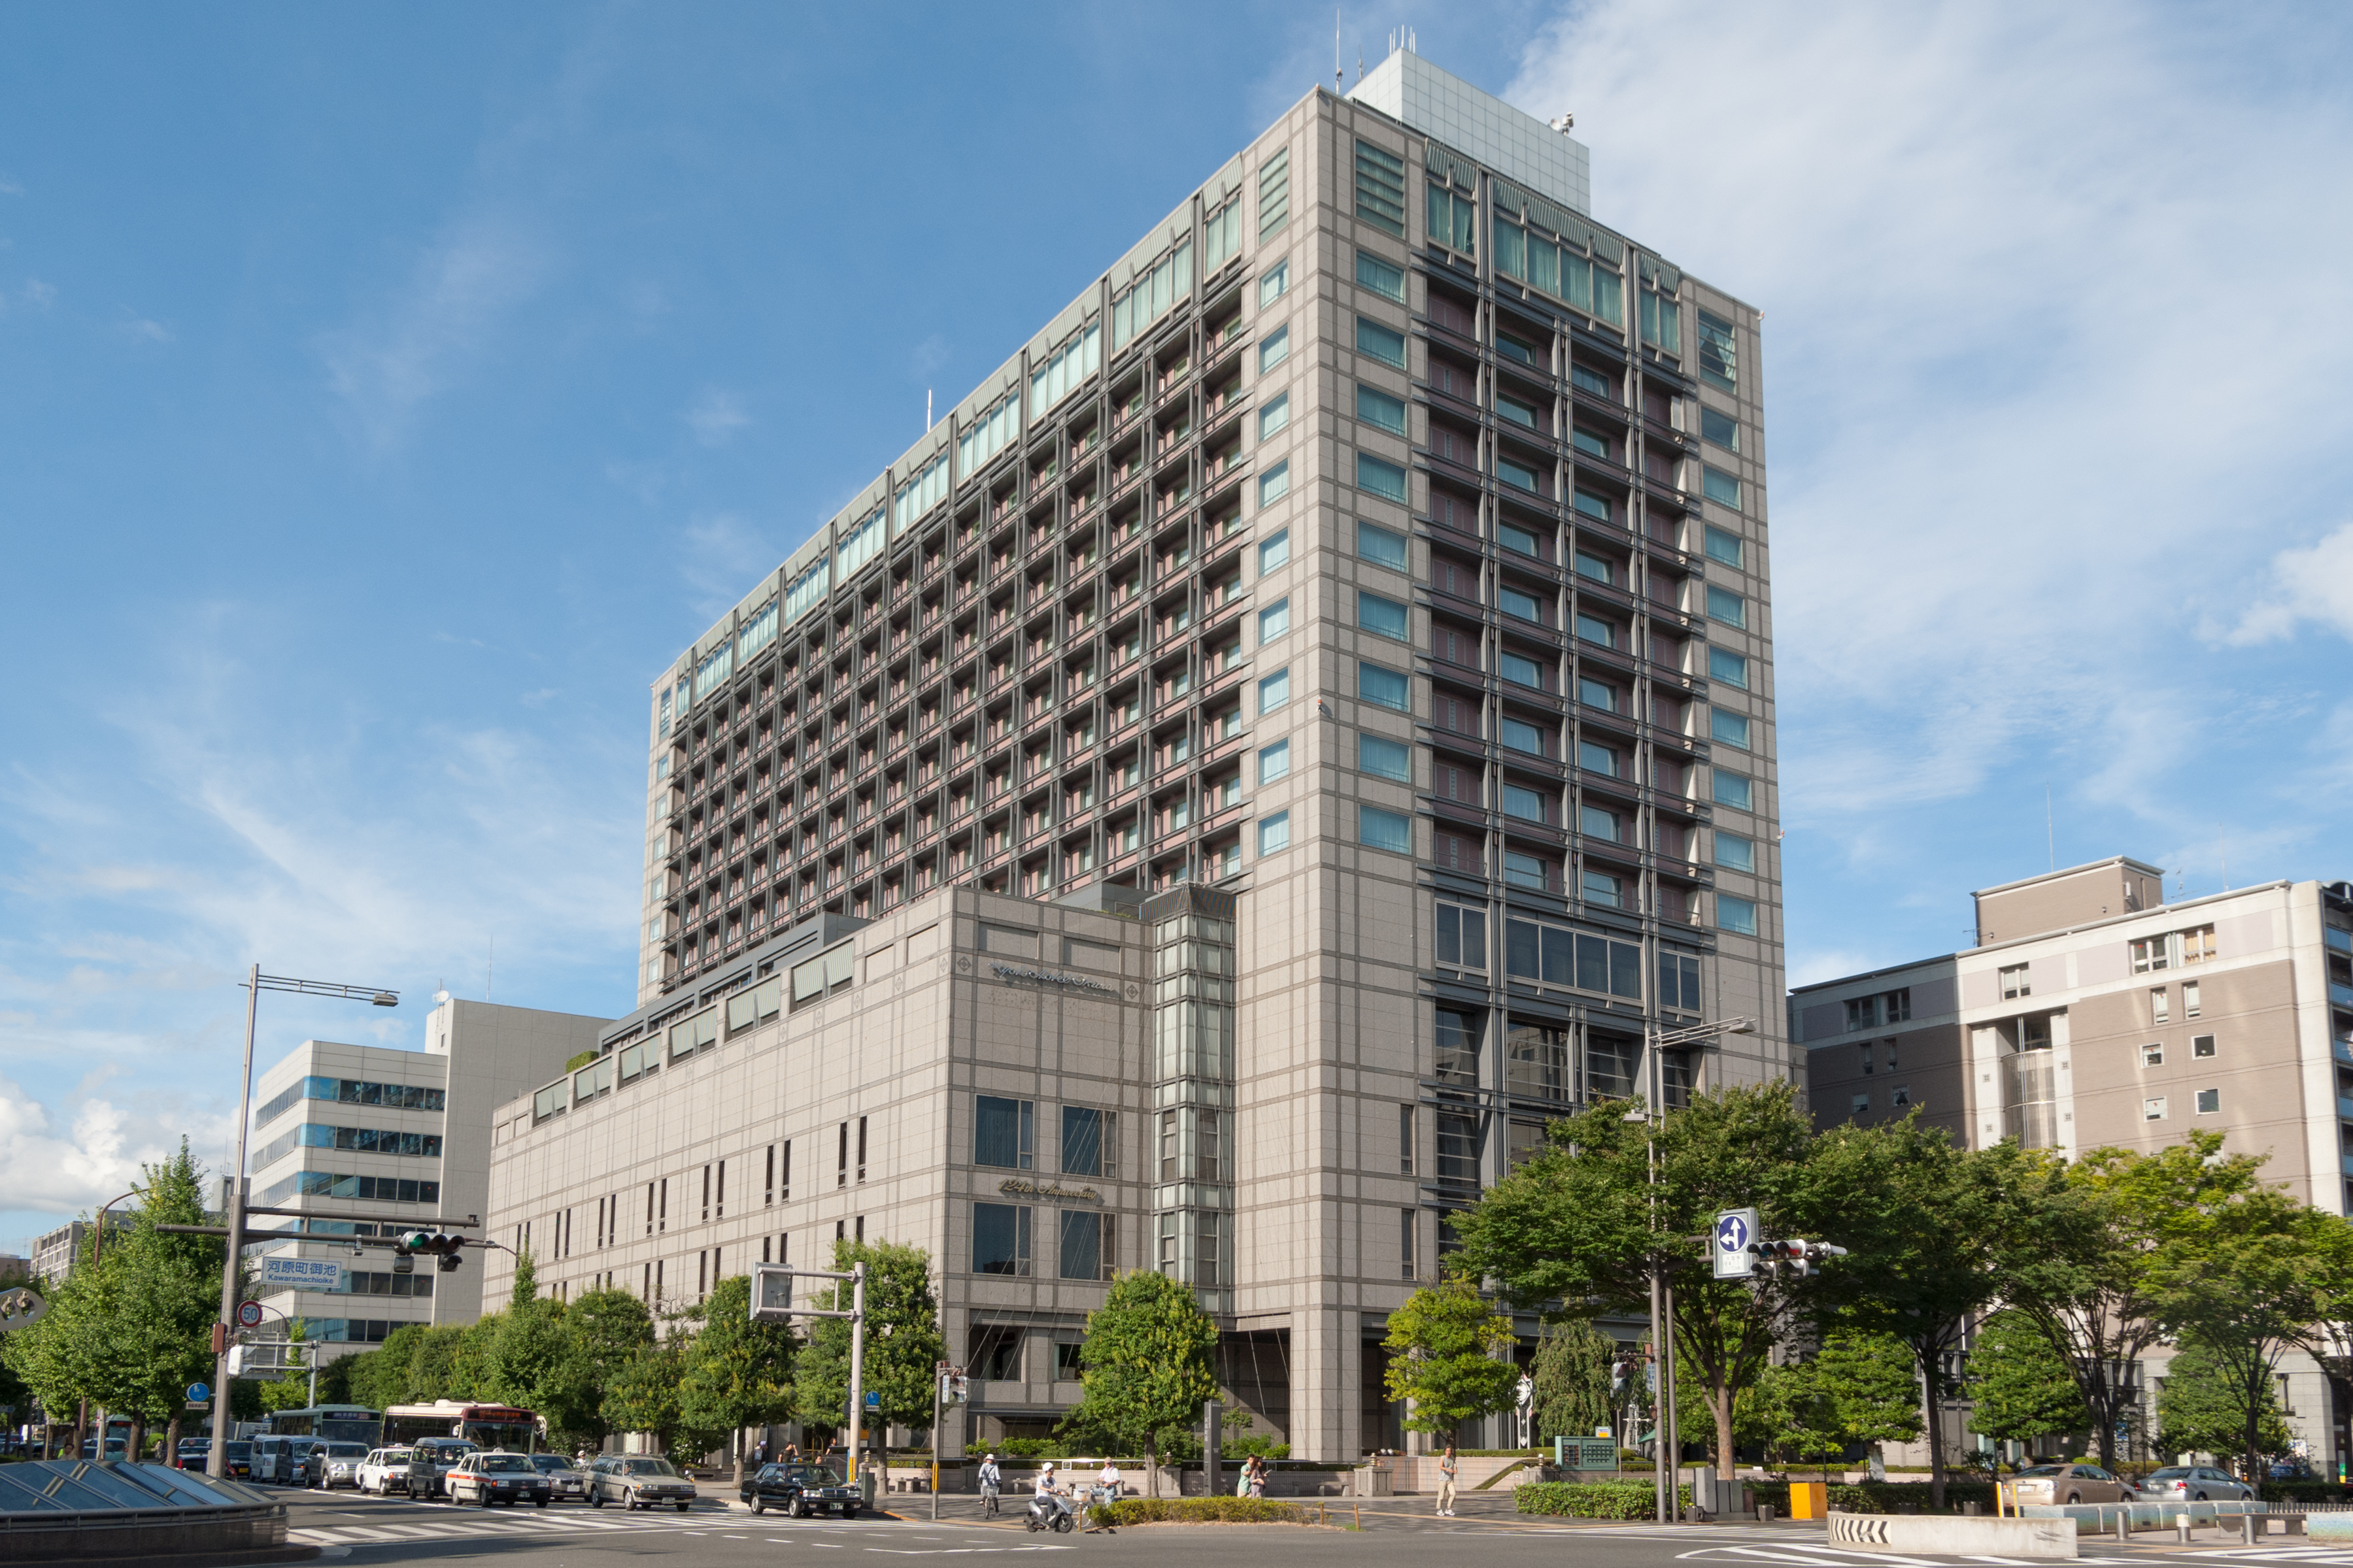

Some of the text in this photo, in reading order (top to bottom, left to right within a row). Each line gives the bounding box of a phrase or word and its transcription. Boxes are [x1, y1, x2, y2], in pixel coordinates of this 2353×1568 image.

[988, 961, 1115, 992] Kyoto Hotel Okura
[998, 1178, 1097, 1200] 124th Anniversary
[267, 1260, 337, 1276] 河原町御池
[268, 1274, 334, 1284] Kawaramachioike
[243, 1307, 258, 1320] 50
